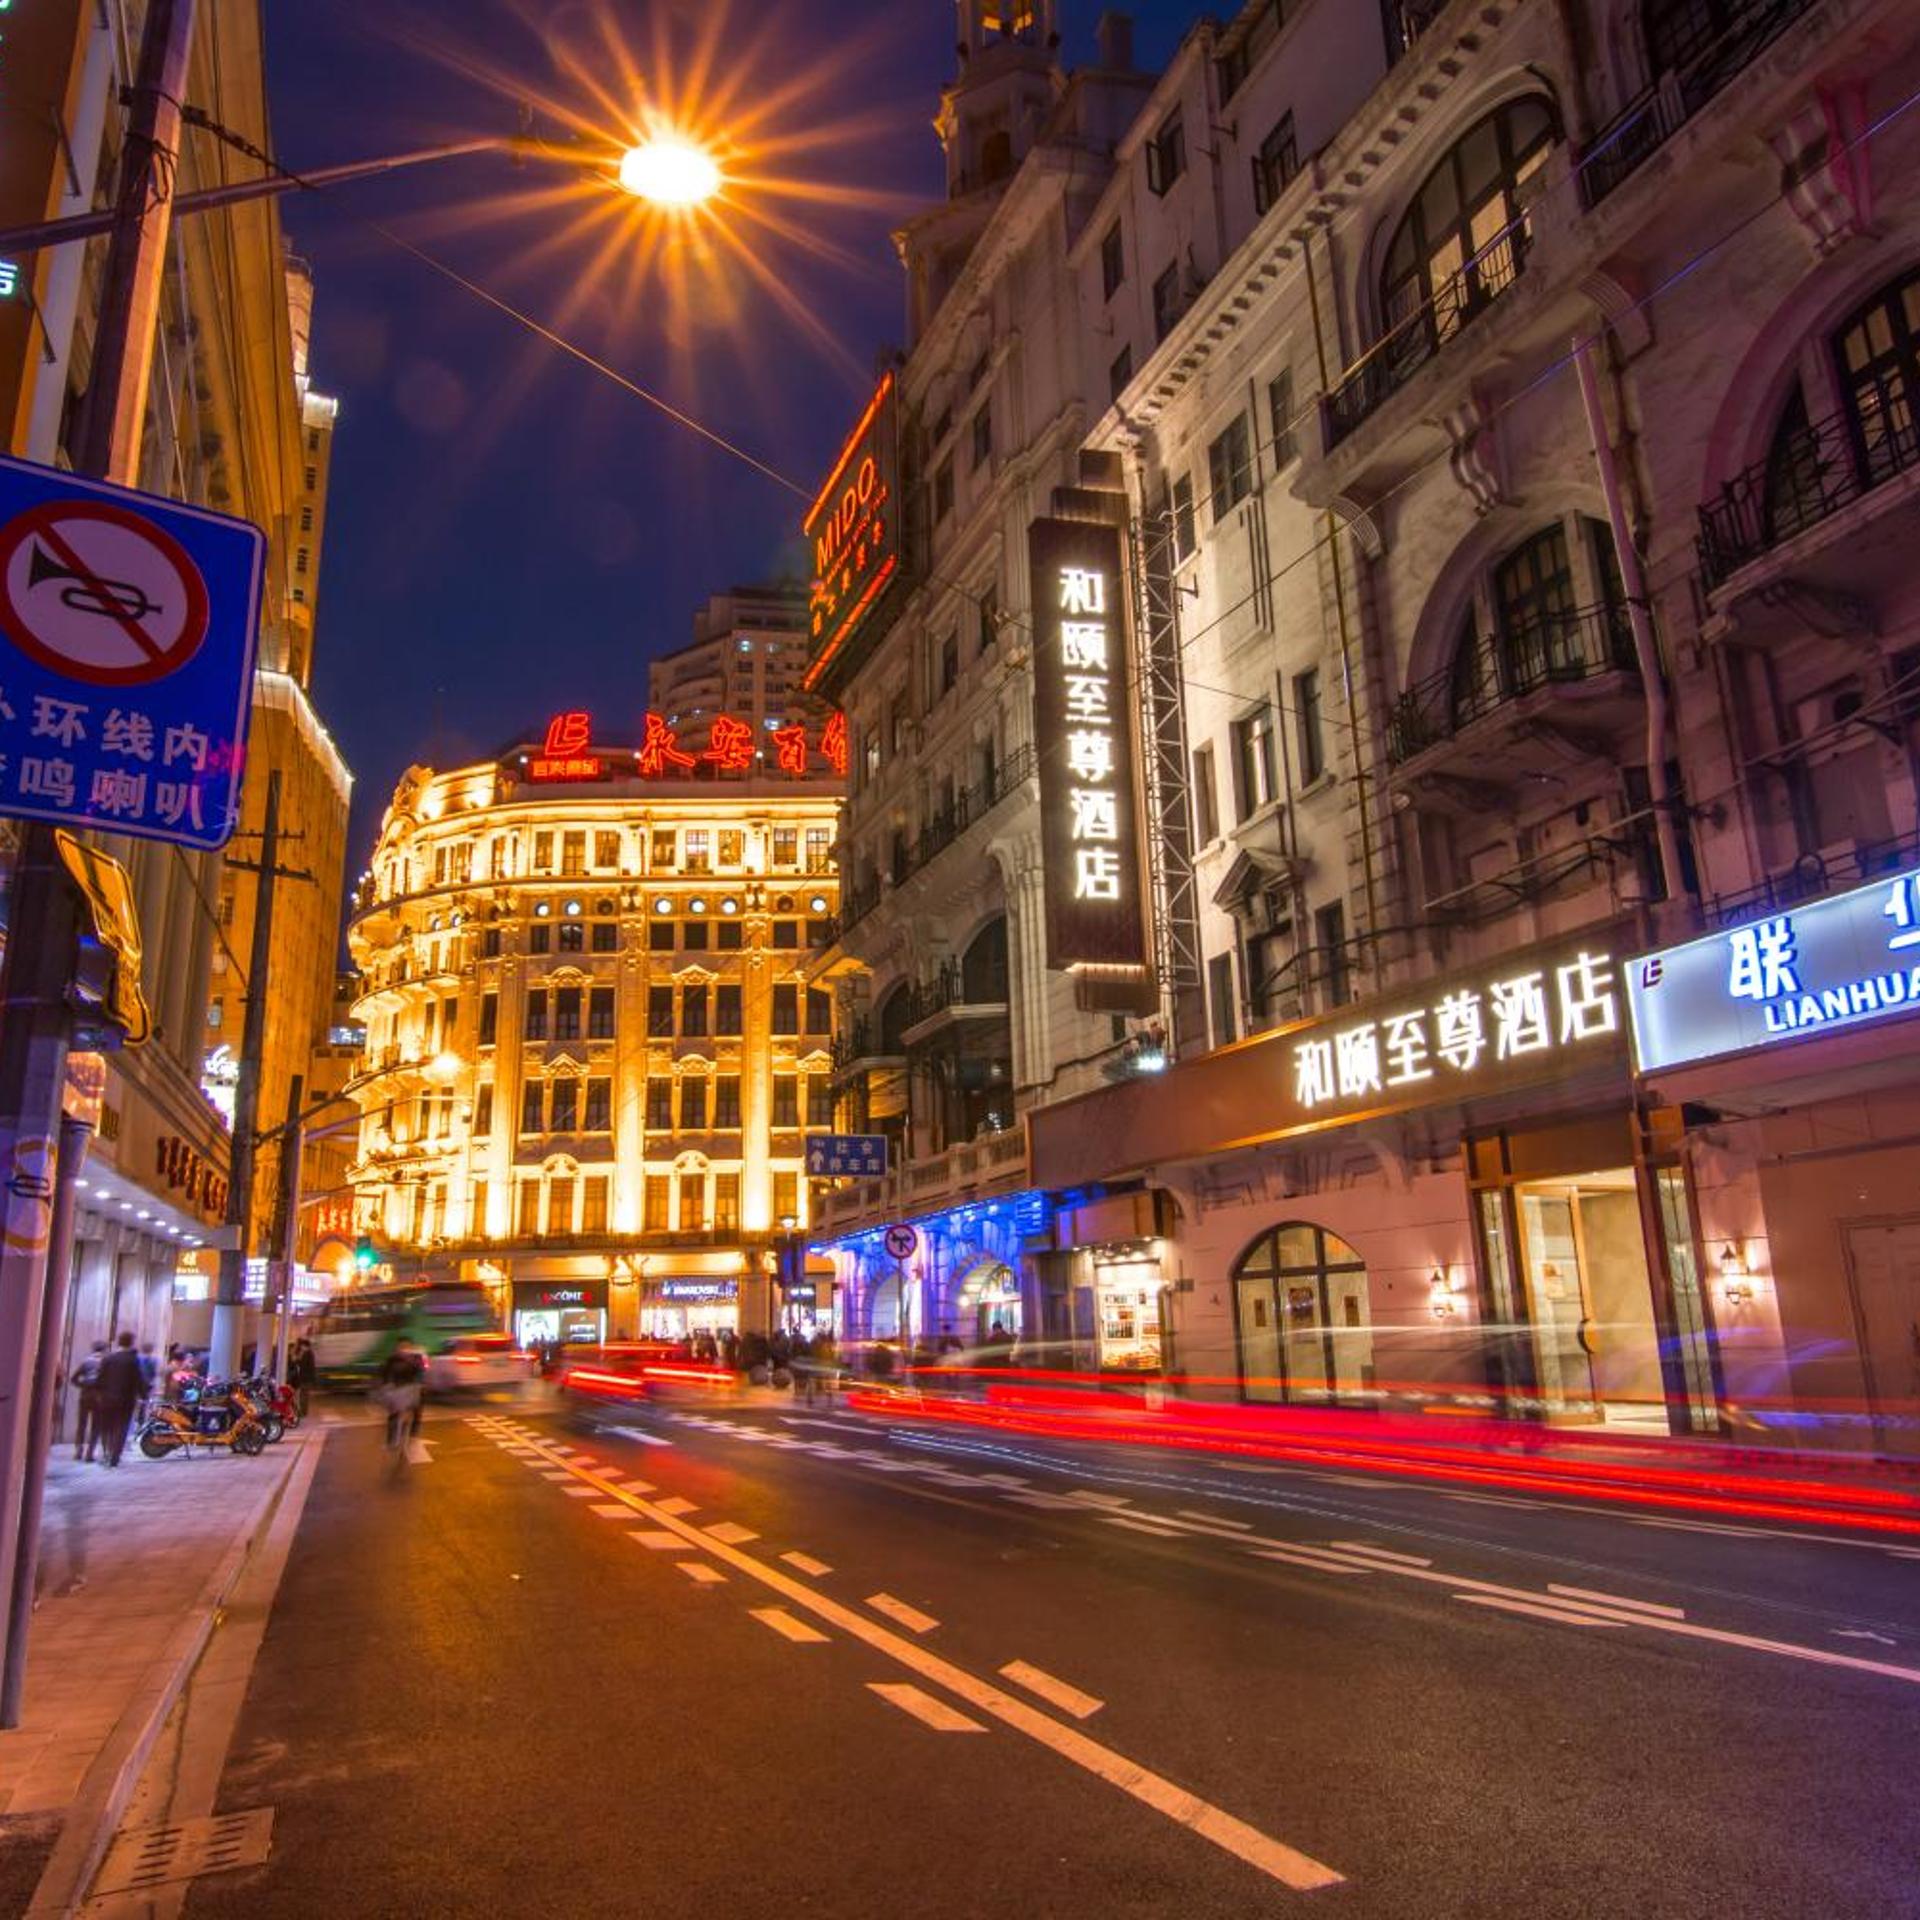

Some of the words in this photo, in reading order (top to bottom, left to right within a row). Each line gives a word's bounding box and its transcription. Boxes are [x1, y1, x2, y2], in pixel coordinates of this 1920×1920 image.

[817, 458, 875, 577] MIDO
[0, 686, 209, 772] 环线内
[1059, 567, 1121, 901] 和颐至尊酒店
[0, 753, 205, 831] 鸣喇叭
[1295, 950, 1617, 1108] 和颐至尊酒店
